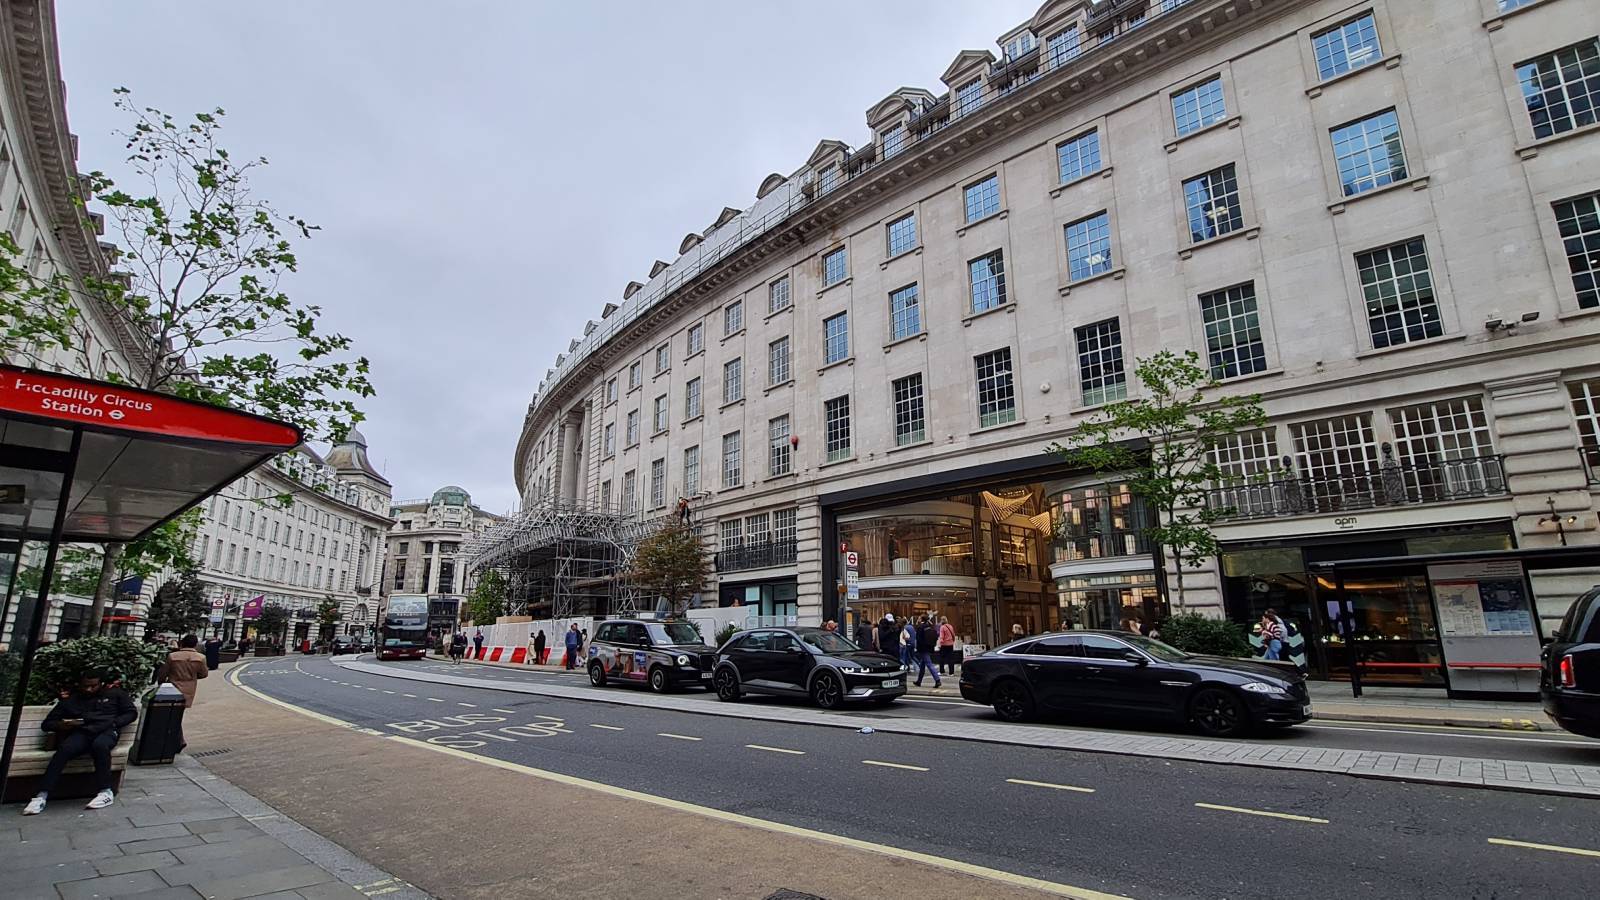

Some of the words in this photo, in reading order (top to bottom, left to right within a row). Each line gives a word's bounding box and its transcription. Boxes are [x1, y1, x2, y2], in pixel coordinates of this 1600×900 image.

[41, 398, 103, 417] Station
[103, 394, 153, 411] Circus
[384, 714, 507, 733] BUS
[426, 722, 575, 748] STOP
